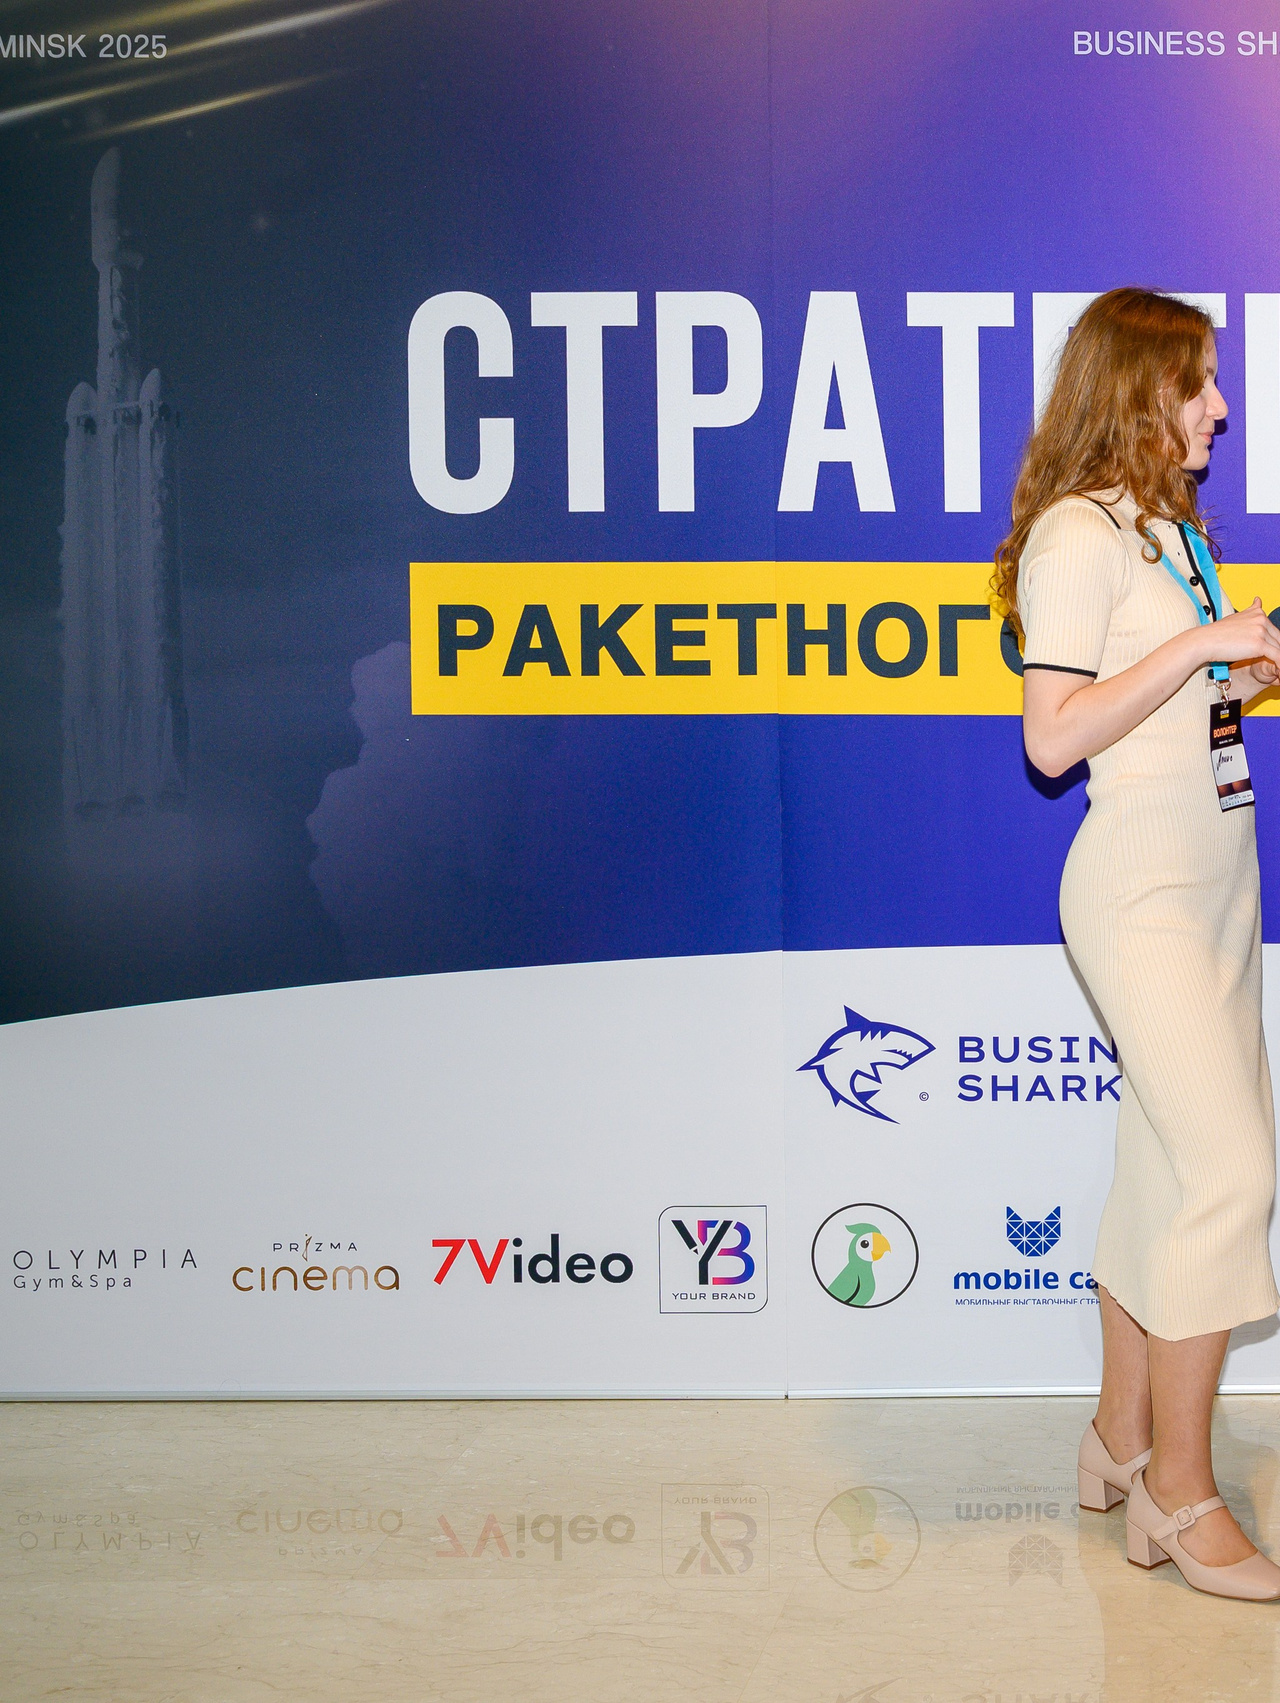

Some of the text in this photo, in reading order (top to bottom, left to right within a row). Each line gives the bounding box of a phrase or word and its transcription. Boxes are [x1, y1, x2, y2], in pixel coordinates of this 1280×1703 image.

[0, 33, 167, 59] MINSK 2025
[1073, 31, 1225, 56] BUSINESS
[958, 1036, 1118, 1064] BUSIN
[957, 1074, 1123, 1102] SHARK
[13, 1249, 197, 1270] OLYMPIA
[431, 1233, 634, 1286] 7Video
[13, 1274, 132, 1292] Gym&Spa
[232, 1265, 400, 1292] cinema
[953, 1268, 1099, 1290] mobile ca
[712, 1292, 756, 1300] BRAND
